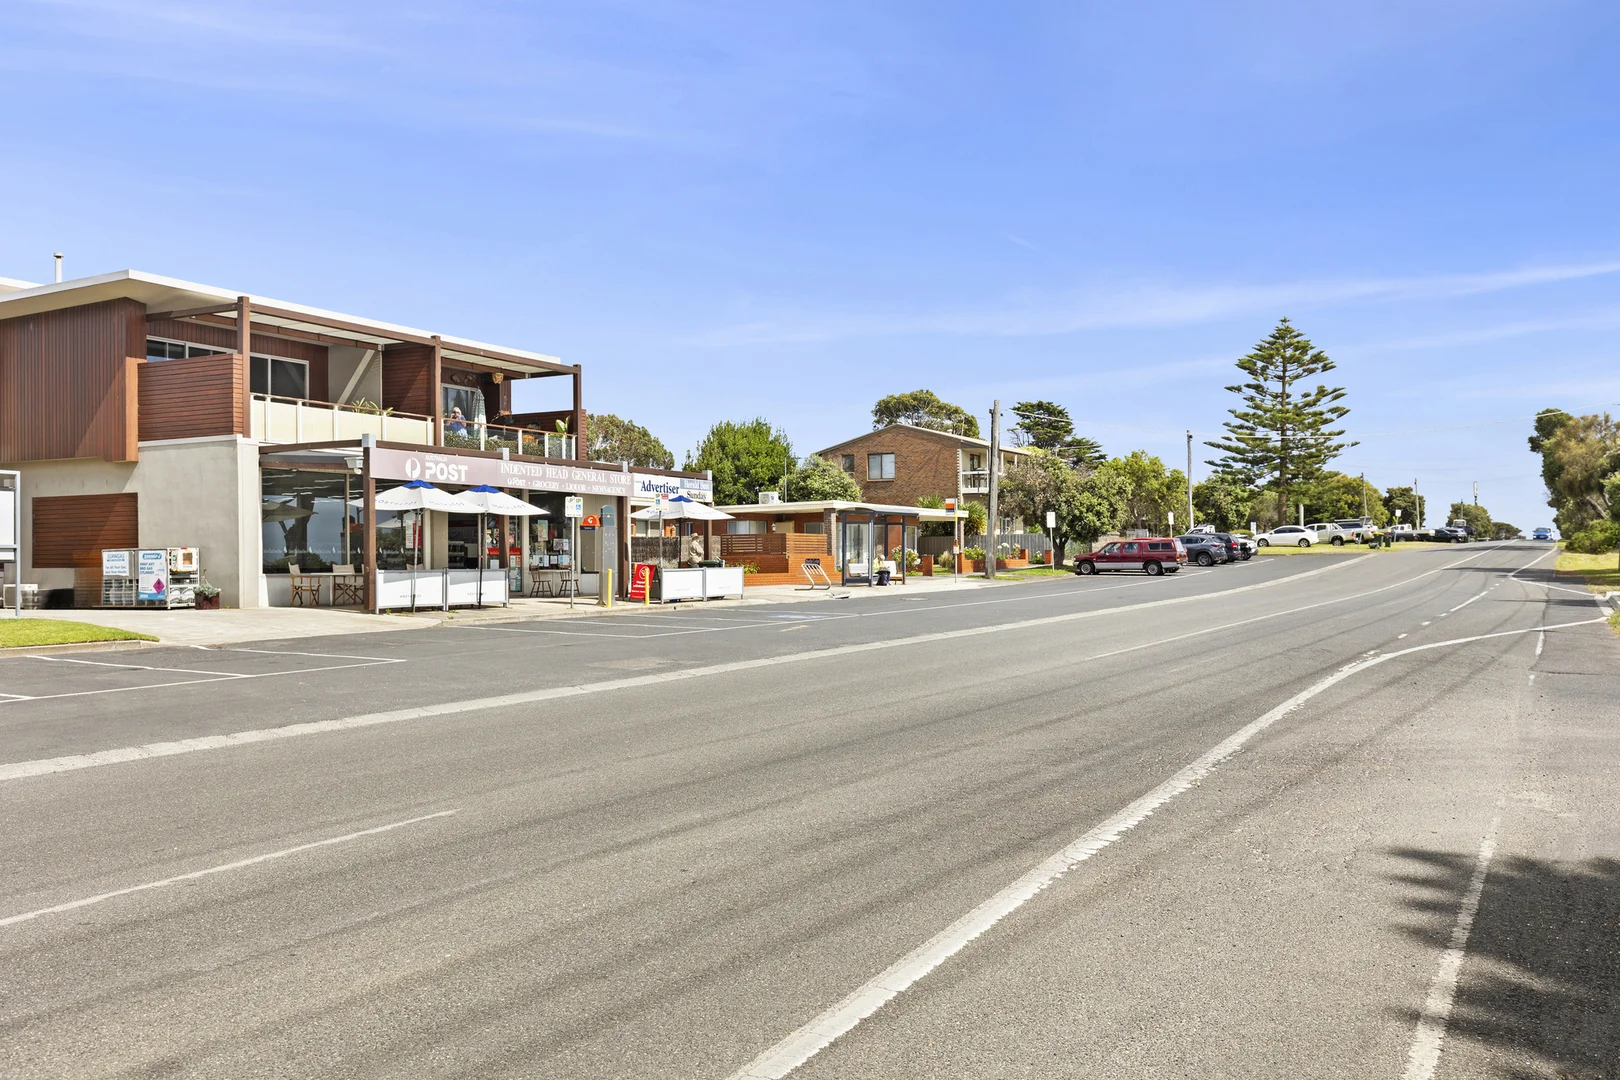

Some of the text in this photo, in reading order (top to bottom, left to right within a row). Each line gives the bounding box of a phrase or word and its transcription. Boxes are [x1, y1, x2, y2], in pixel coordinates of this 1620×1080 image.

[425, 462, 468, 482] POST
[500, 462, 632, 485] INDENTED HEAD GENERAL STORE
[532, 480, 560, 490] GROCERY
[566, 482, 587, 491] LIQUOR
[592, 484, 626, 494] NEWSAGENCY
[641, 479, 680, 495] Advertiser
[686, 490, 707, 502] Sunday
